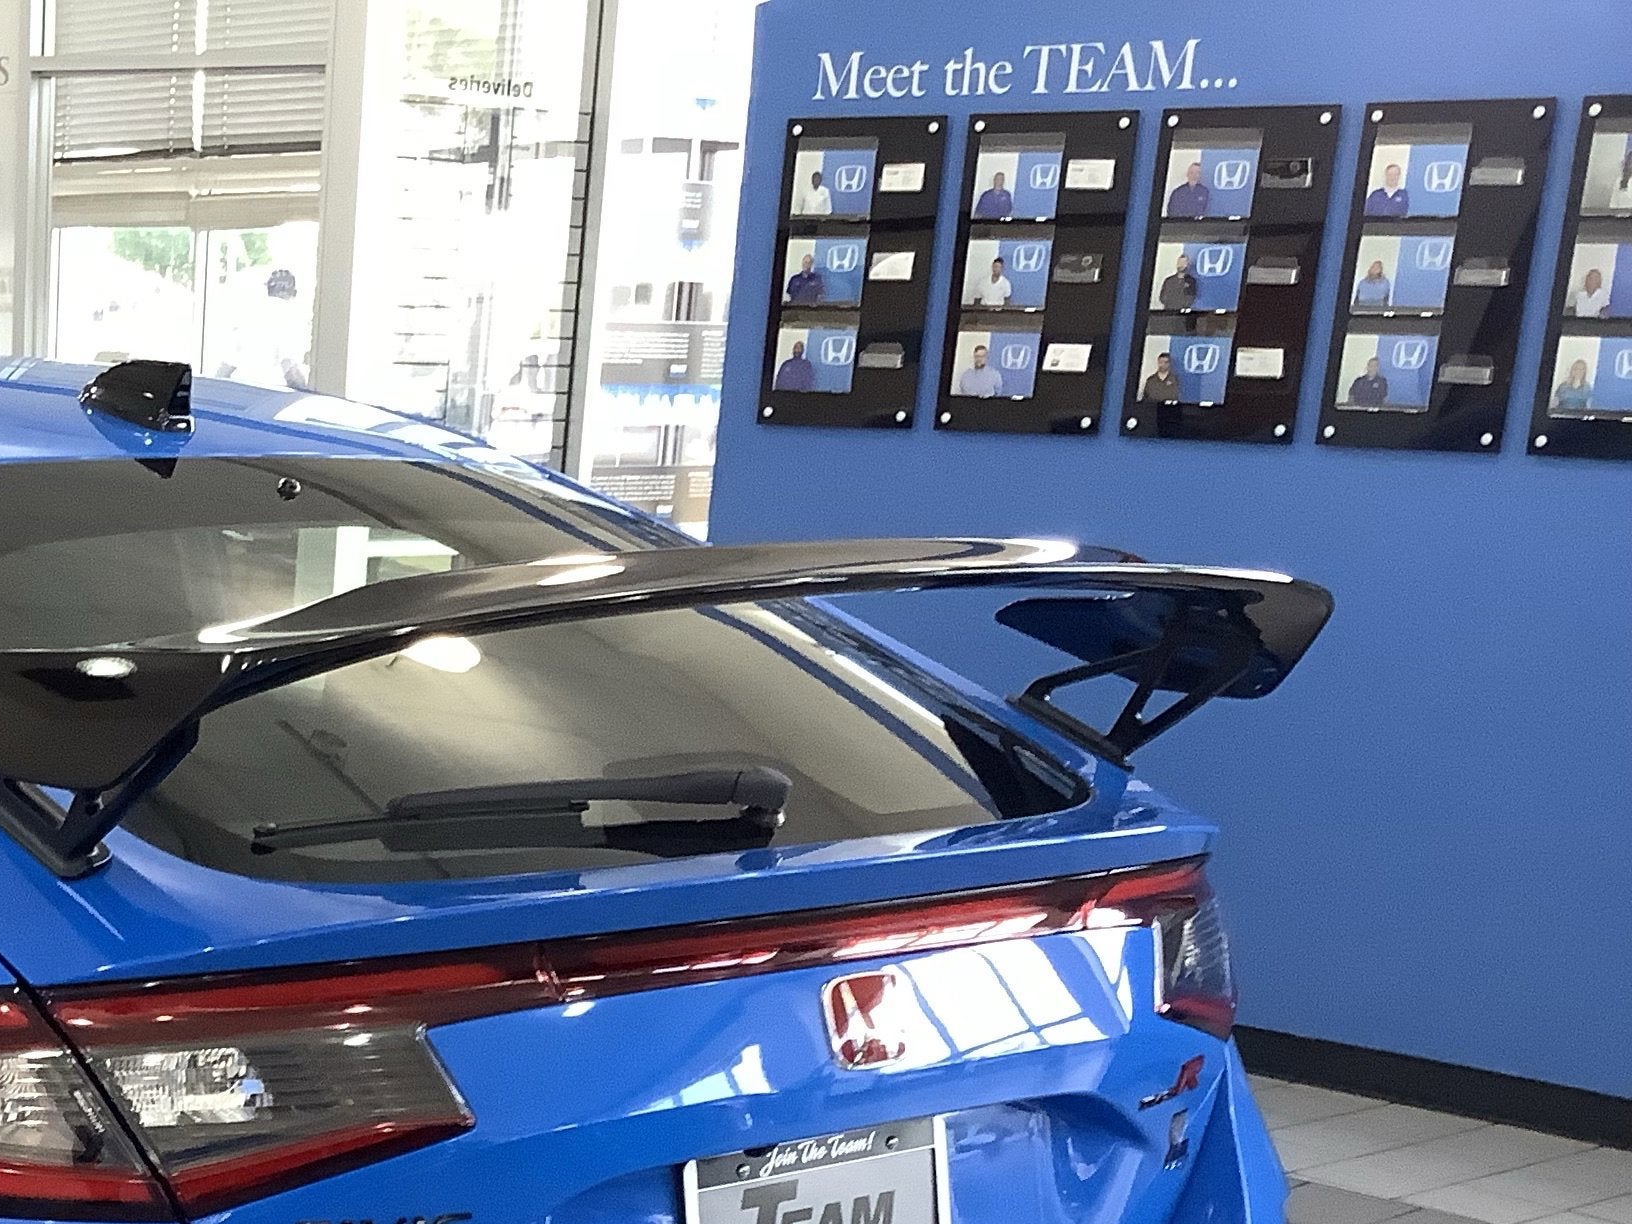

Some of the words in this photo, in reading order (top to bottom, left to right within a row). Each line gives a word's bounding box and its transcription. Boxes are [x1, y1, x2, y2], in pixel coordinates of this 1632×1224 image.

[812, 50, 929, 100] Meet
[944, 46, 1013, 96] the
[1023, 38, 1238, 94] TEAM...
[760, 1149, 797, 1176] Join
[800, 1141, 826, 1163] The
[830, 1131, 875, 1157] Team!
